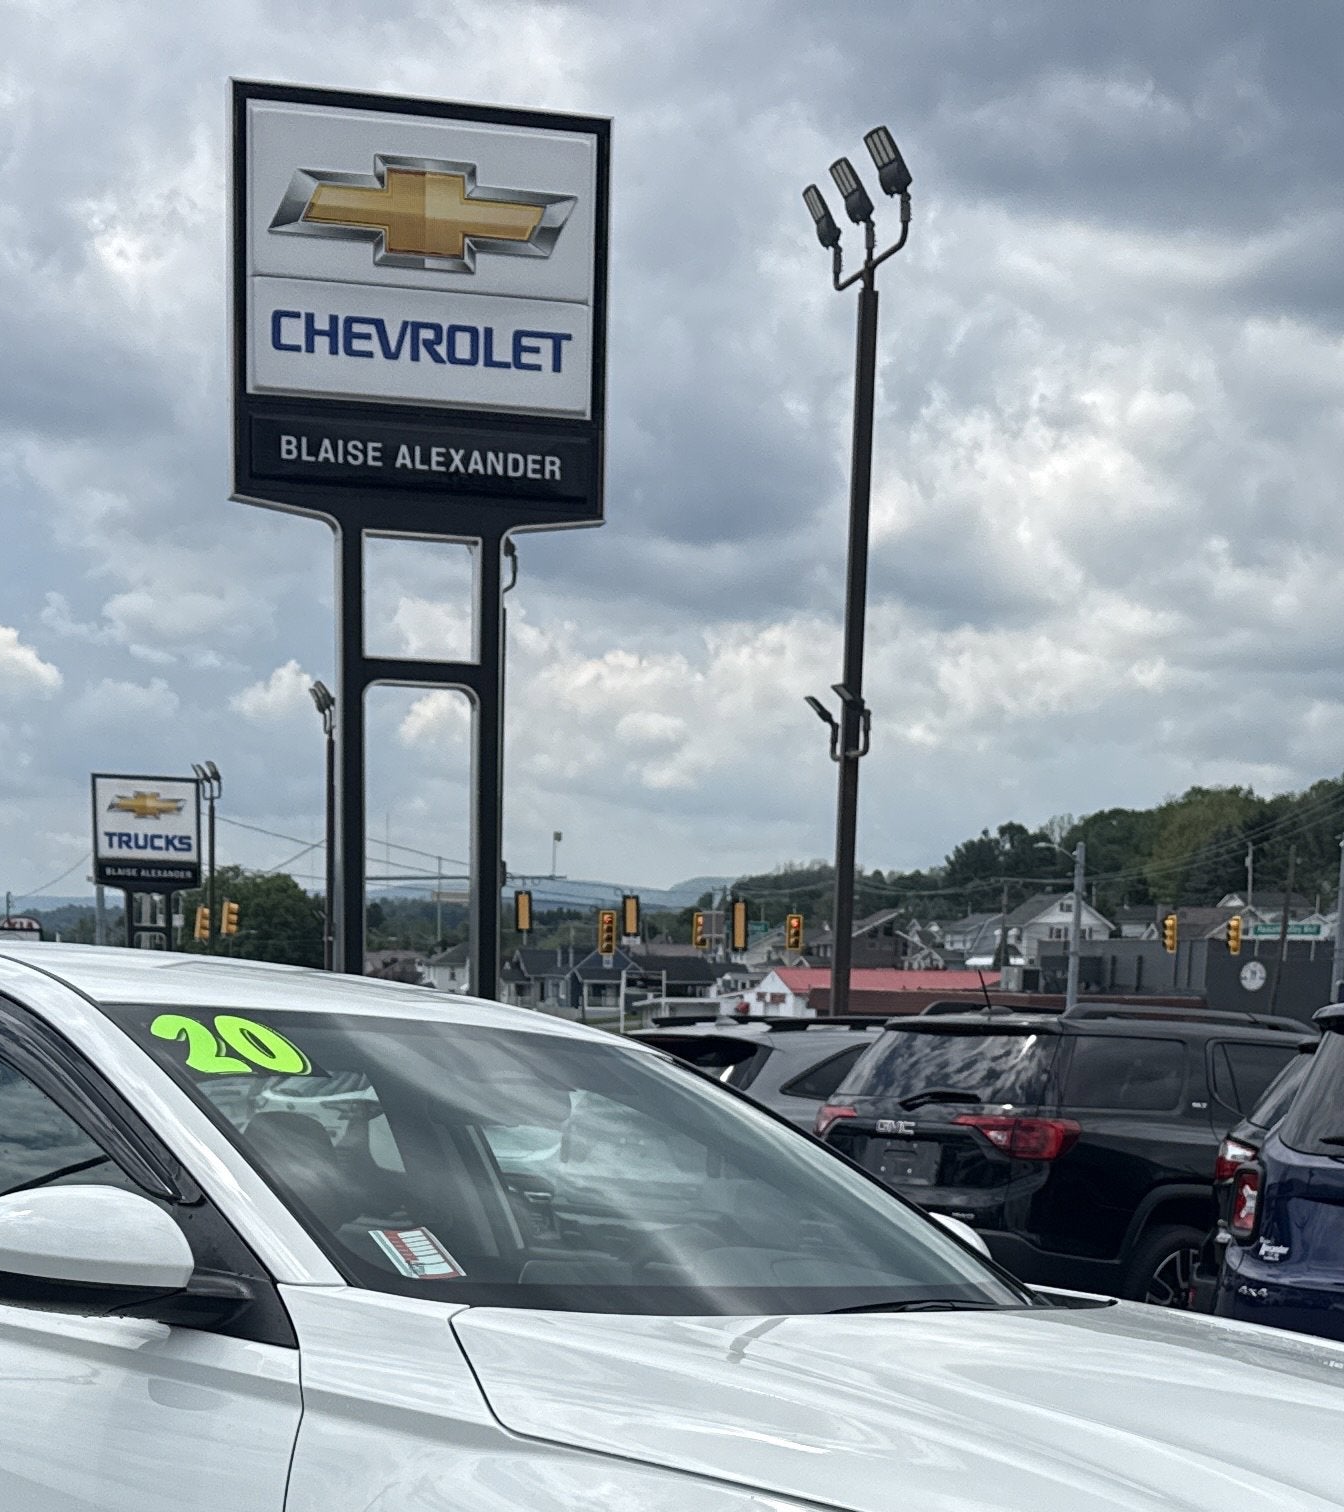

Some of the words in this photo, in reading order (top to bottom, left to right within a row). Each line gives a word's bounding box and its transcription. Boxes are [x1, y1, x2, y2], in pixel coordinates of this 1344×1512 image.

[271, 309, 572, 373] CHEVROLET
[280, 435, 383, 467] BLAISE
[395, 444, 562, 481] ALEXANDER
[104, 832, 192, 852] TRUCKS
[105, 866, 138, 877] BLAISE
[141, 869, 193, 879] ALEXANDER
[150, 1013, 312, 1076] 20
[877, 1119, 916, 1136] GMC
